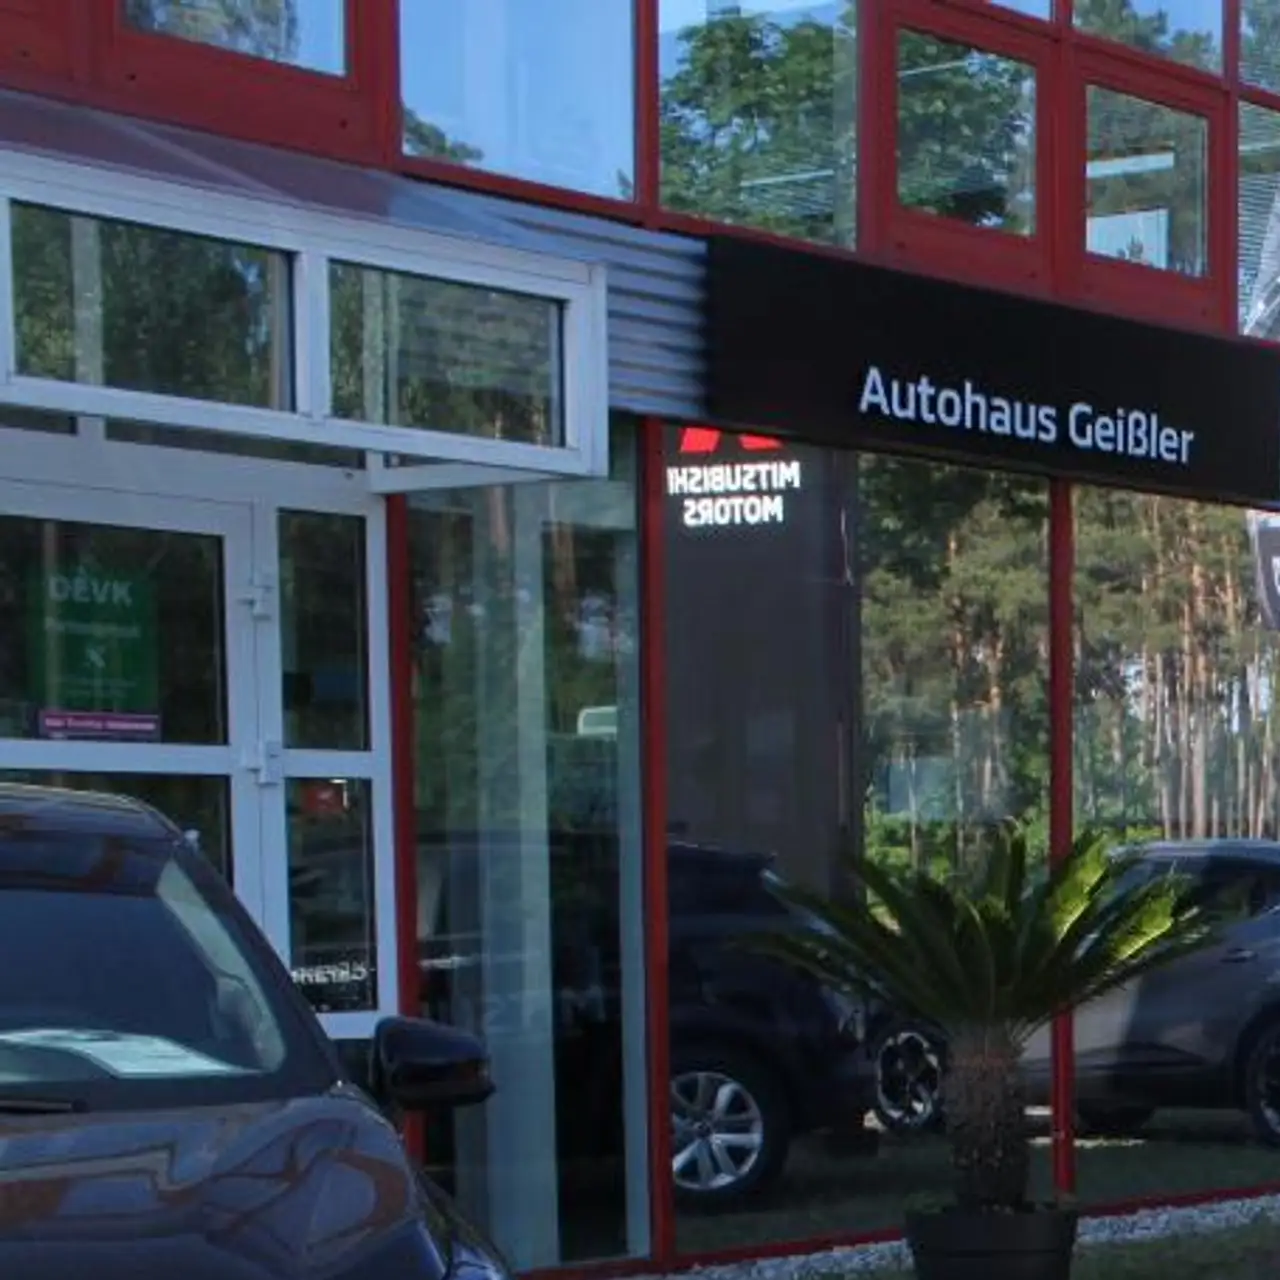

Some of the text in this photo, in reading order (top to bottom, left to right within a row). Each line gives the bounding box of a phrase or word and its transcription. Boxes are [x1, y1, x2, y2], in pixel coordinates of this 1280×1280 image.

[859, 366, 1194, 464] Autohaus Geißler
[49, 575, 133, 606] DEVK
